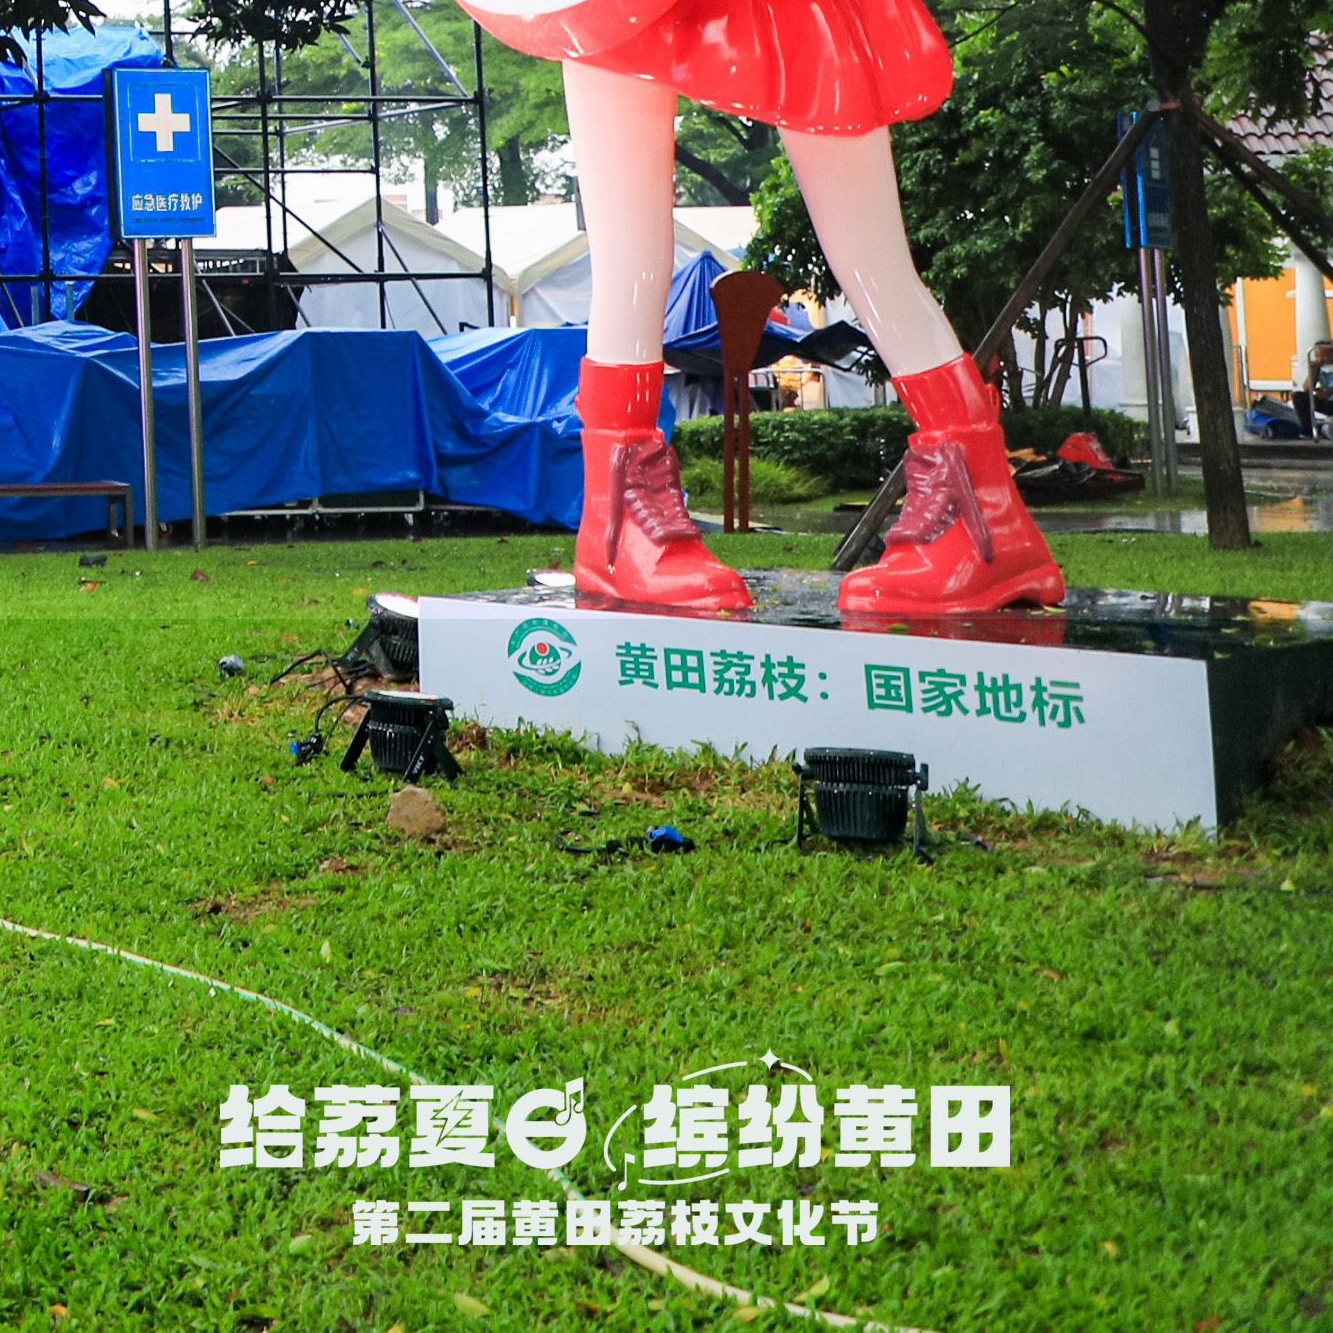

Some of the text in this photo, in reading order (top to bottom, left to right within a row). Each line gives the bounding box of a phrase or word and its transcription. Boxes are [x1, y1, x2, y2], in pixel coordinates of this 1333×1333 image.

[132, 193, 203, 212] 应急医疗救护
